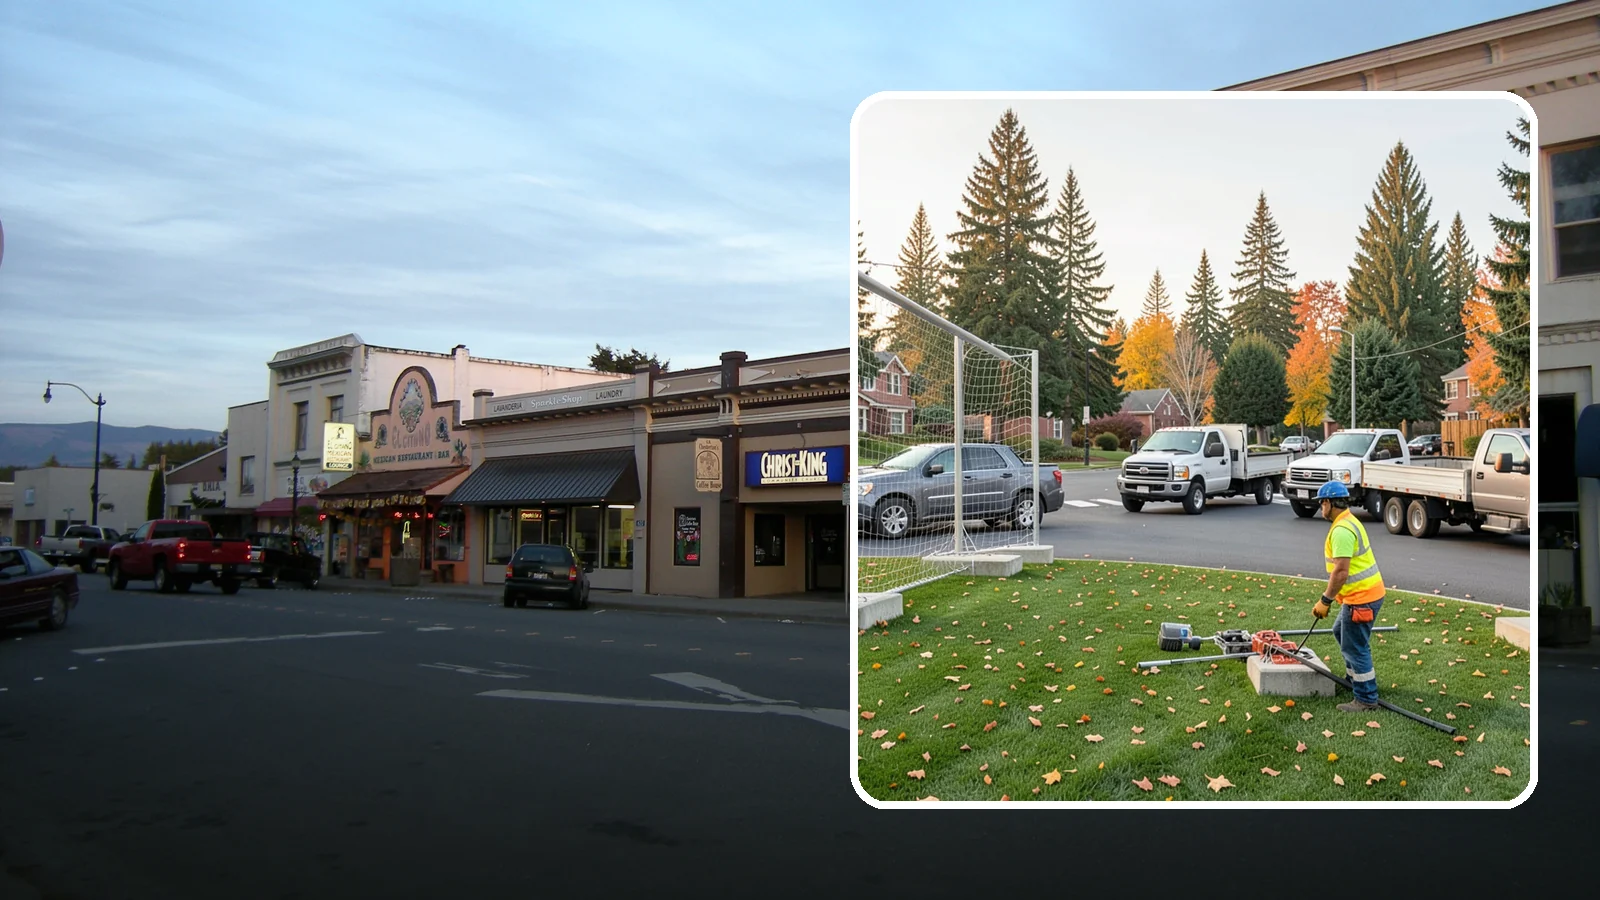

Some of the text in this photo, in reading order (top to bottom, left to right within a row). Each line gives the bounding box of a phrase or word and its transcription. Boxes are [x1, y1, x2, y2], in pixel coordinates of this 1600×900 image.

[595, 389, 623, 400] LAUNDRY
[493, 402, 522, 412] LAVANDERIA
[531, 394, 582, 408] Sparkle Shop
[373, 455, 396, 464] MEXICAN
[397, 451, 433, 462] RESTAURANT
[437, 450, 450, 459] BAR
[761, 450, 827, 478] CHRIST KING
[696, 480, 709, 488] Coffee
